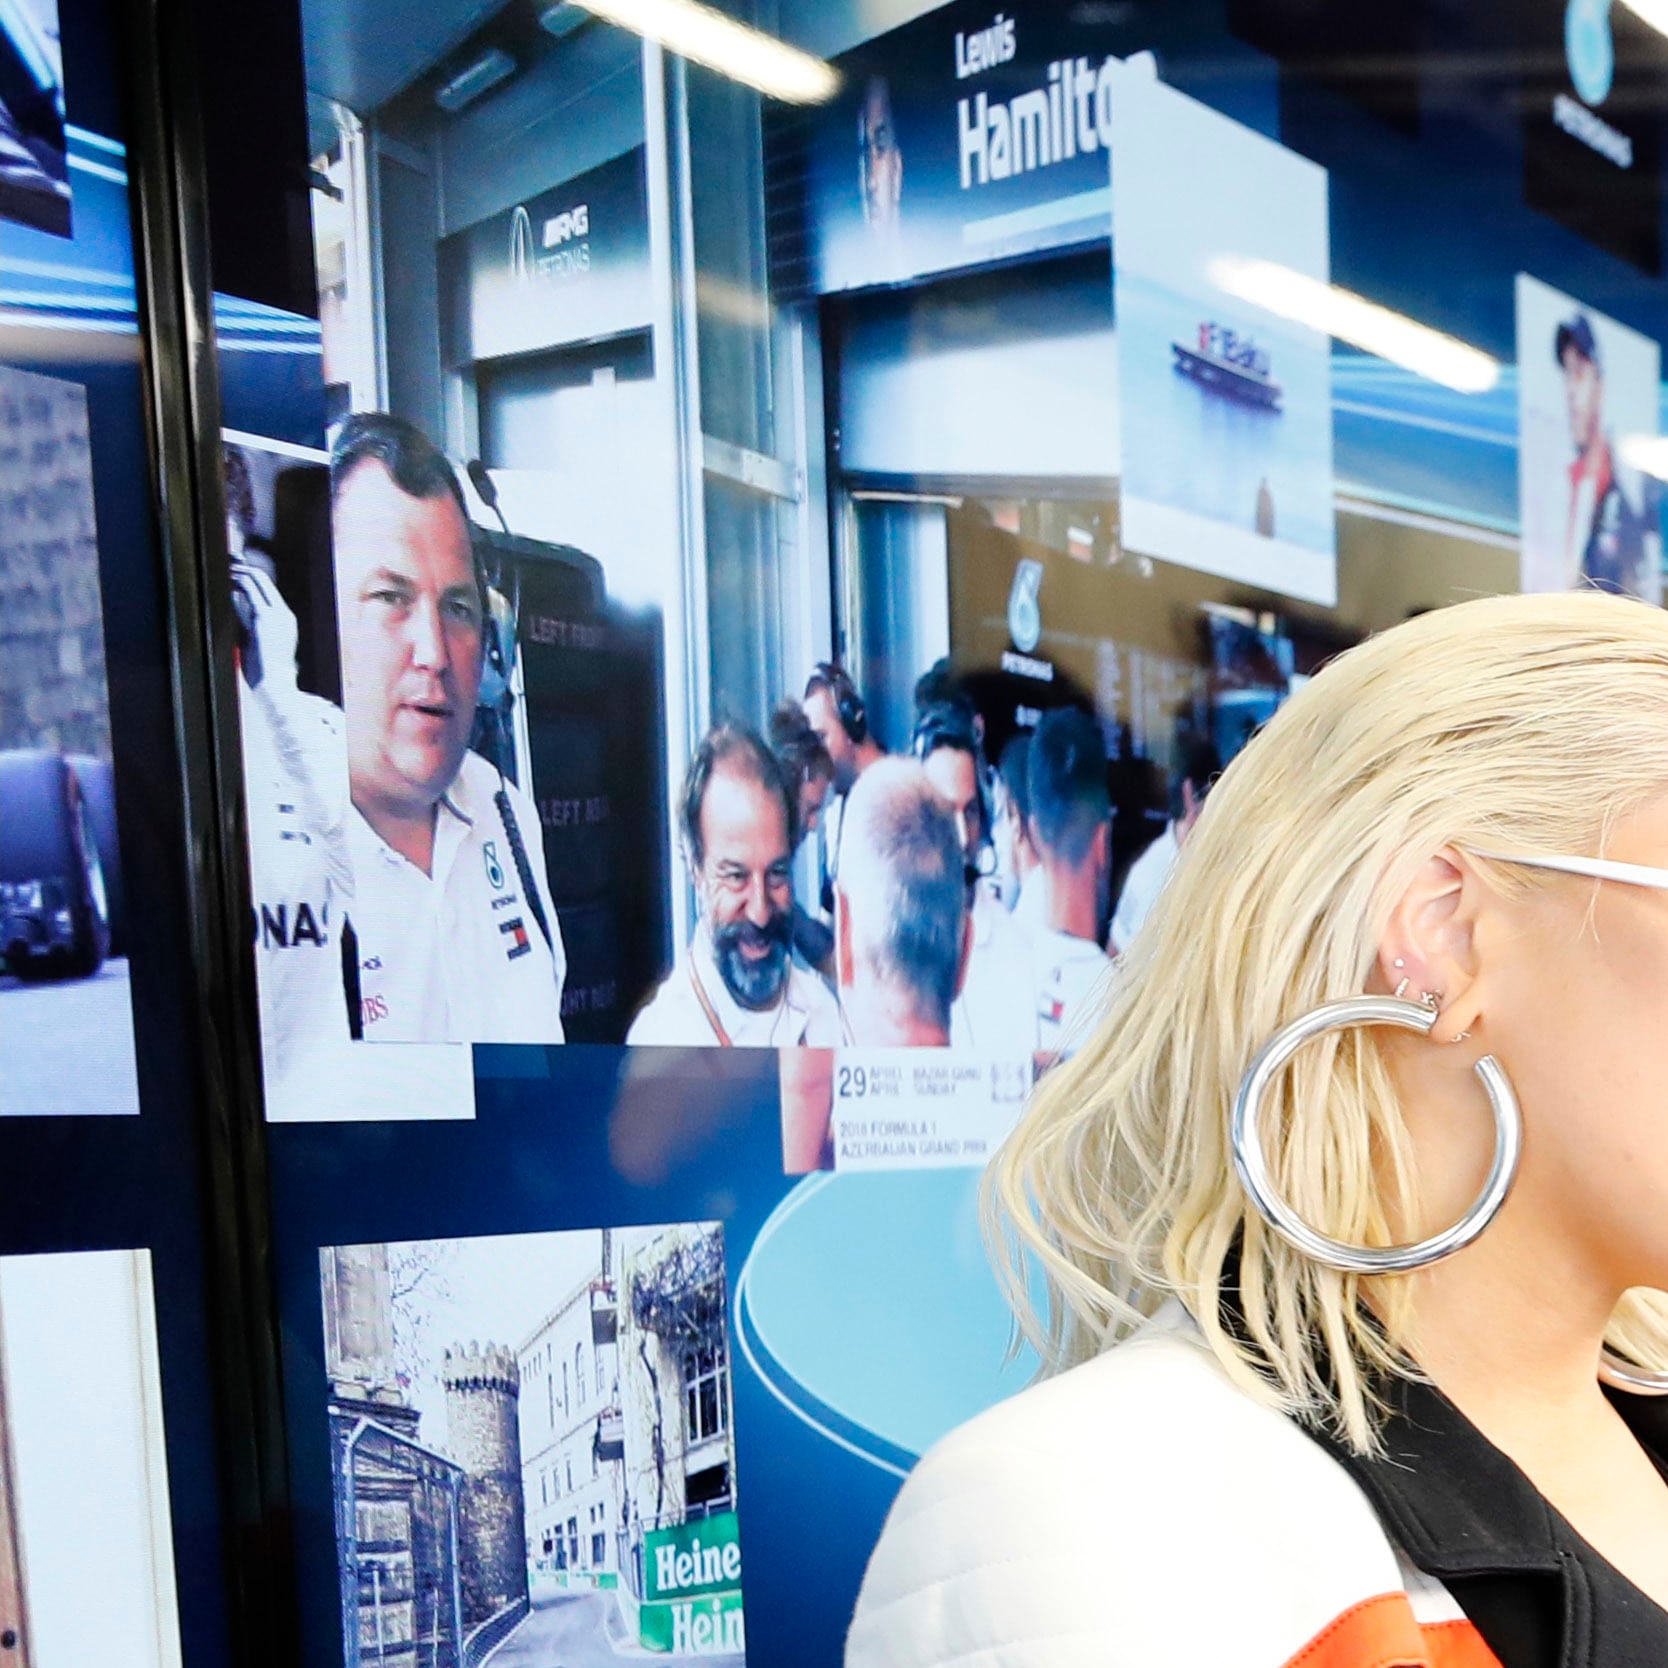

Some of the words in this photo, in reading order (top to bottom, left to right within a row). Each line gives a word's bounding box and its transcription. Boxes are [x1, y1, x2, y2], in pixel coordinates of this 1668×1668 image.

[955, 13, 1016, 80] Lewis
[957, 49, 1159, 190] Hamilto
[839, 1066, 867, 1098] 29
[655, 1538, 742, 1591] Heine
[671, 1598, 746, 1655] Hein
